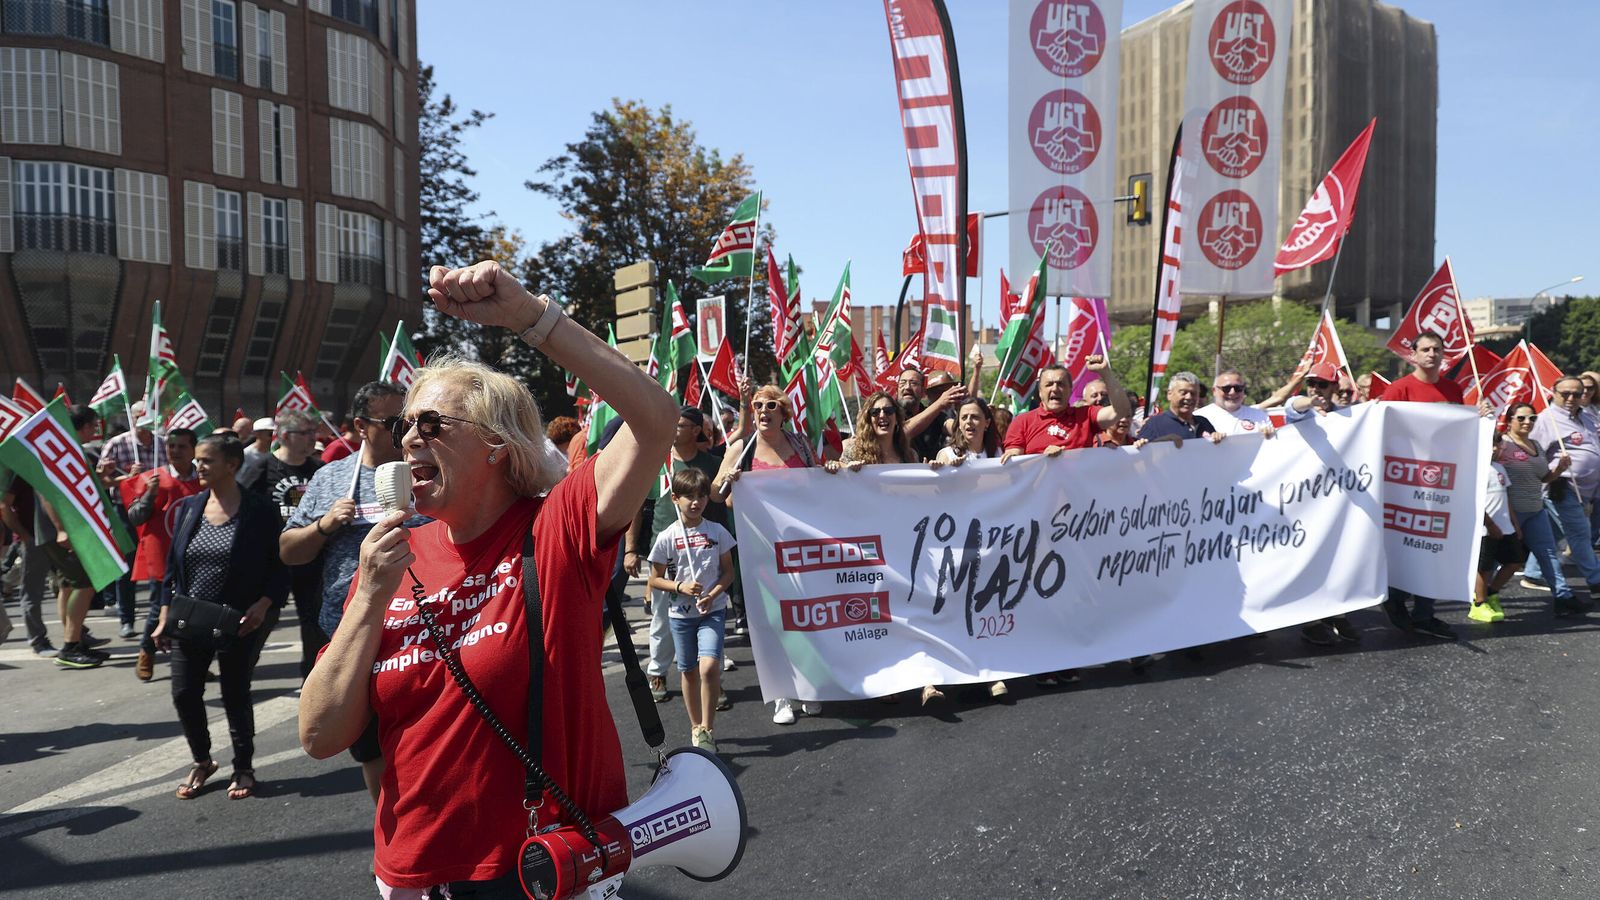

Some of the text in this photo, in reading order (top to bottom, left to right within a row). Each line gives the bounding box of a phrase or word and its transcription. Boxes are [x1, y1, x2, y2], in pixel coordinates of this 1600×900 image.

[1046, 3, 1090, 35] UGT
[1224, 12, 1264, 42] UGT
[1043, 101, 1087, 134] UGT
[1216, 109, 1257, 138] UGT
[1043, 198, 1084, 228] UGT
[1212, 202, 1250, 230] UGT
[1051, 499, 1115, 542] Subir
[1200, 486, 1264, 525] bajar
[1279, 463, 1373, 515] precios
[1413, 490, 1451, 505] Málaga
[987, 523, 1016, 550] DE
[1403, 536, 1444, 554] Málaga
[782, 543, 861, 568] CCOO
[1097, 519, 1307, 586] repartir beneficios
[836, 570, 884, 584] Málaga
[933, 518, 1067, 637] MAYO
[388, 597, 415, 611] En
[791, 600, 841, 628] UGT
[400, 635, 416, 650] y
[462, 612, 481, 632] un
[844, 627, 888, 643] Málaga
[977, 613, 1016, 640] 2023
[652, 806, 702, 837] CCOO
[689, 822, 710, 834] Málaga
